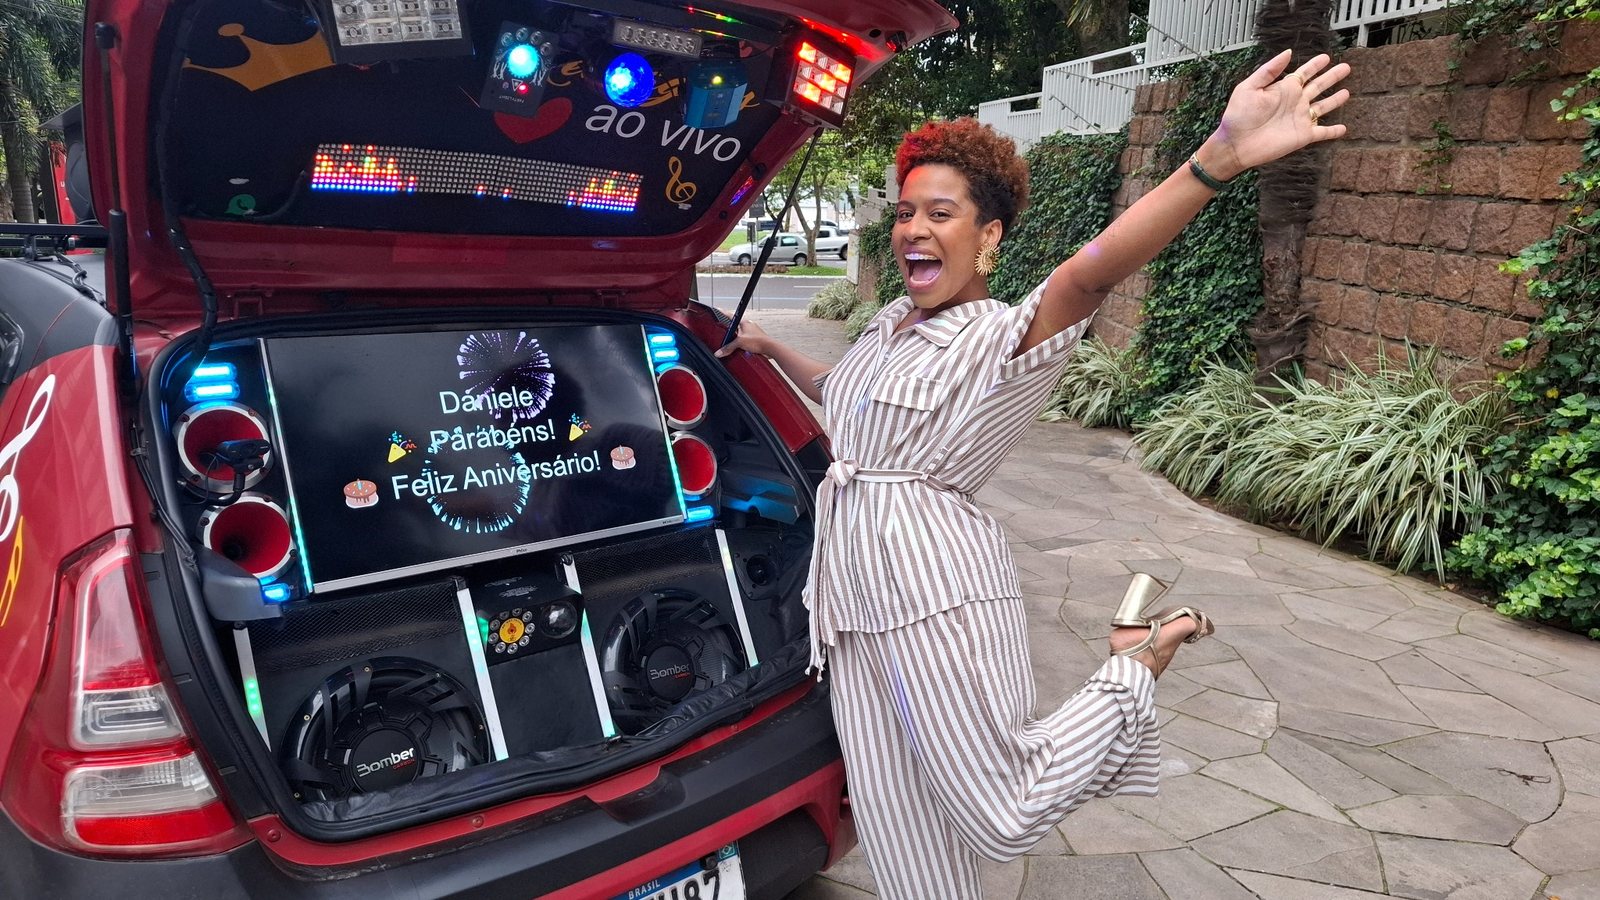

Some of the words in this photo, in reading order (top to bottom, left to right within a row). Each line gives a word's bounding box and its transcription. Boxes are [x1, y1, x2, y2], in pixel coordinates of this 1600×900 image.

[585, 104, 646, 138] ao
[660, 119, 741, 162] vivo
[439, 386, 534, 414] Daniele
[430, 419, 556, 452] Parabéns!
[391, 470, 458, 500] Feliz
[463, 450, 601, 490] Aniversário!
[650, 663, 690, 680] Bomber
[356, 747, 415, 777] Bomber
[628, 879, 661, 900] BRASIL
